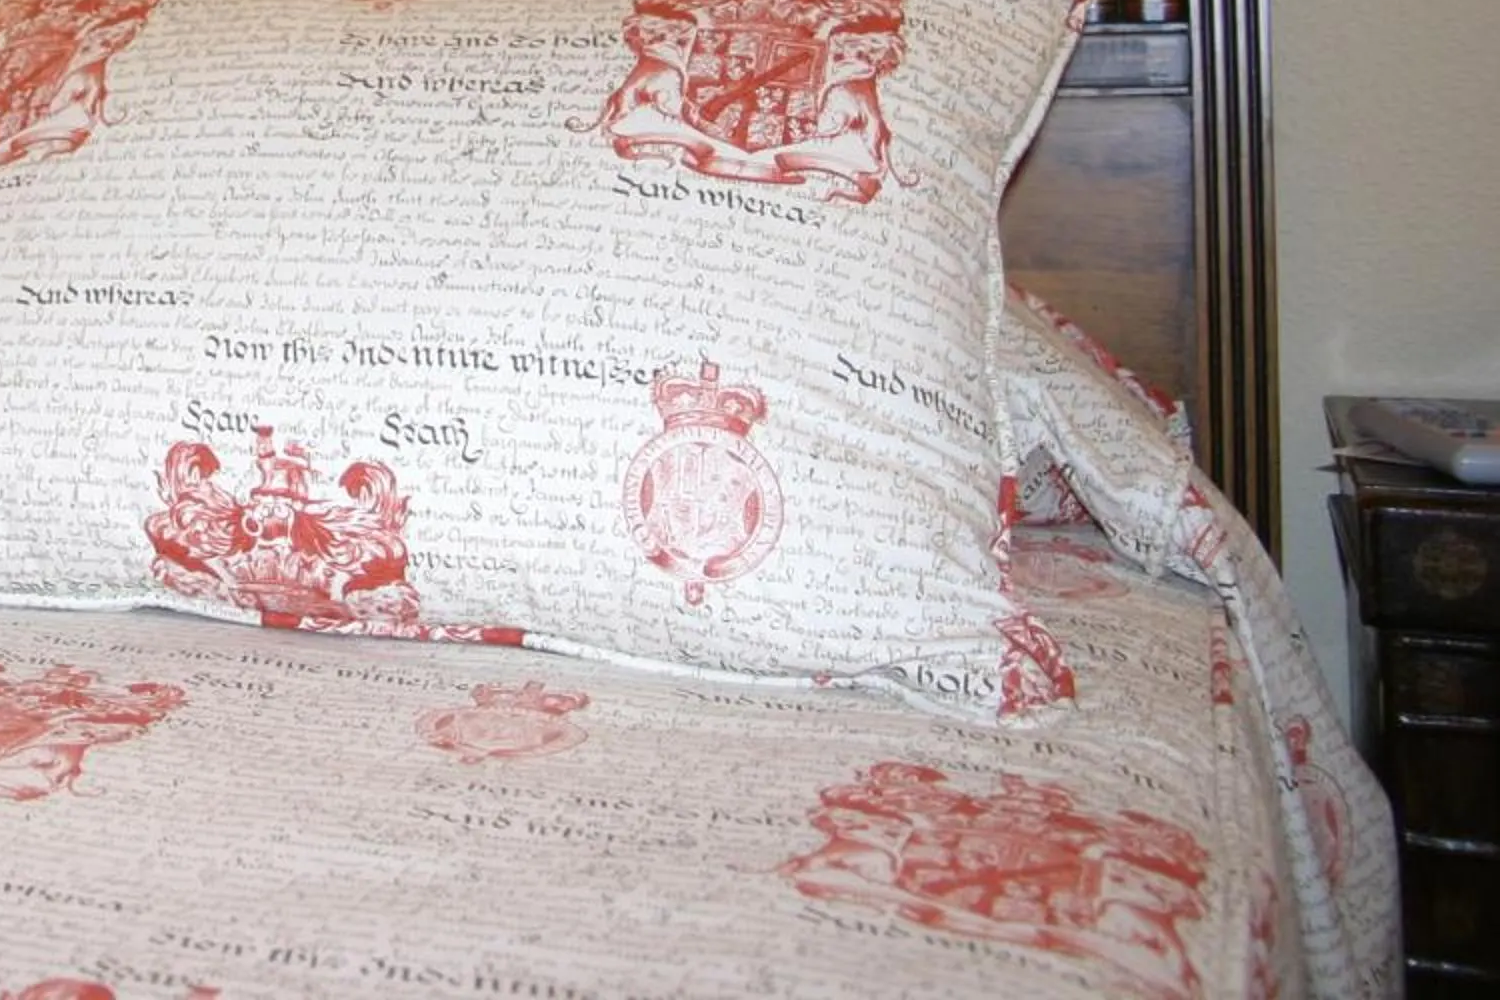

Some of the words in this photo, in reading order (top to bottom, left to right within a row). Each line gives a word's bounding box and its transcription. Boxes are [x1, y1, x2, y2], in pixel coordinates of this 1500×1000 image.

[422, 73, 546, 94] whereas
[698, 186, 826, 229] whereas
[84, 281, 195, 307] whereas
[204, 334, 275, 362] Now
